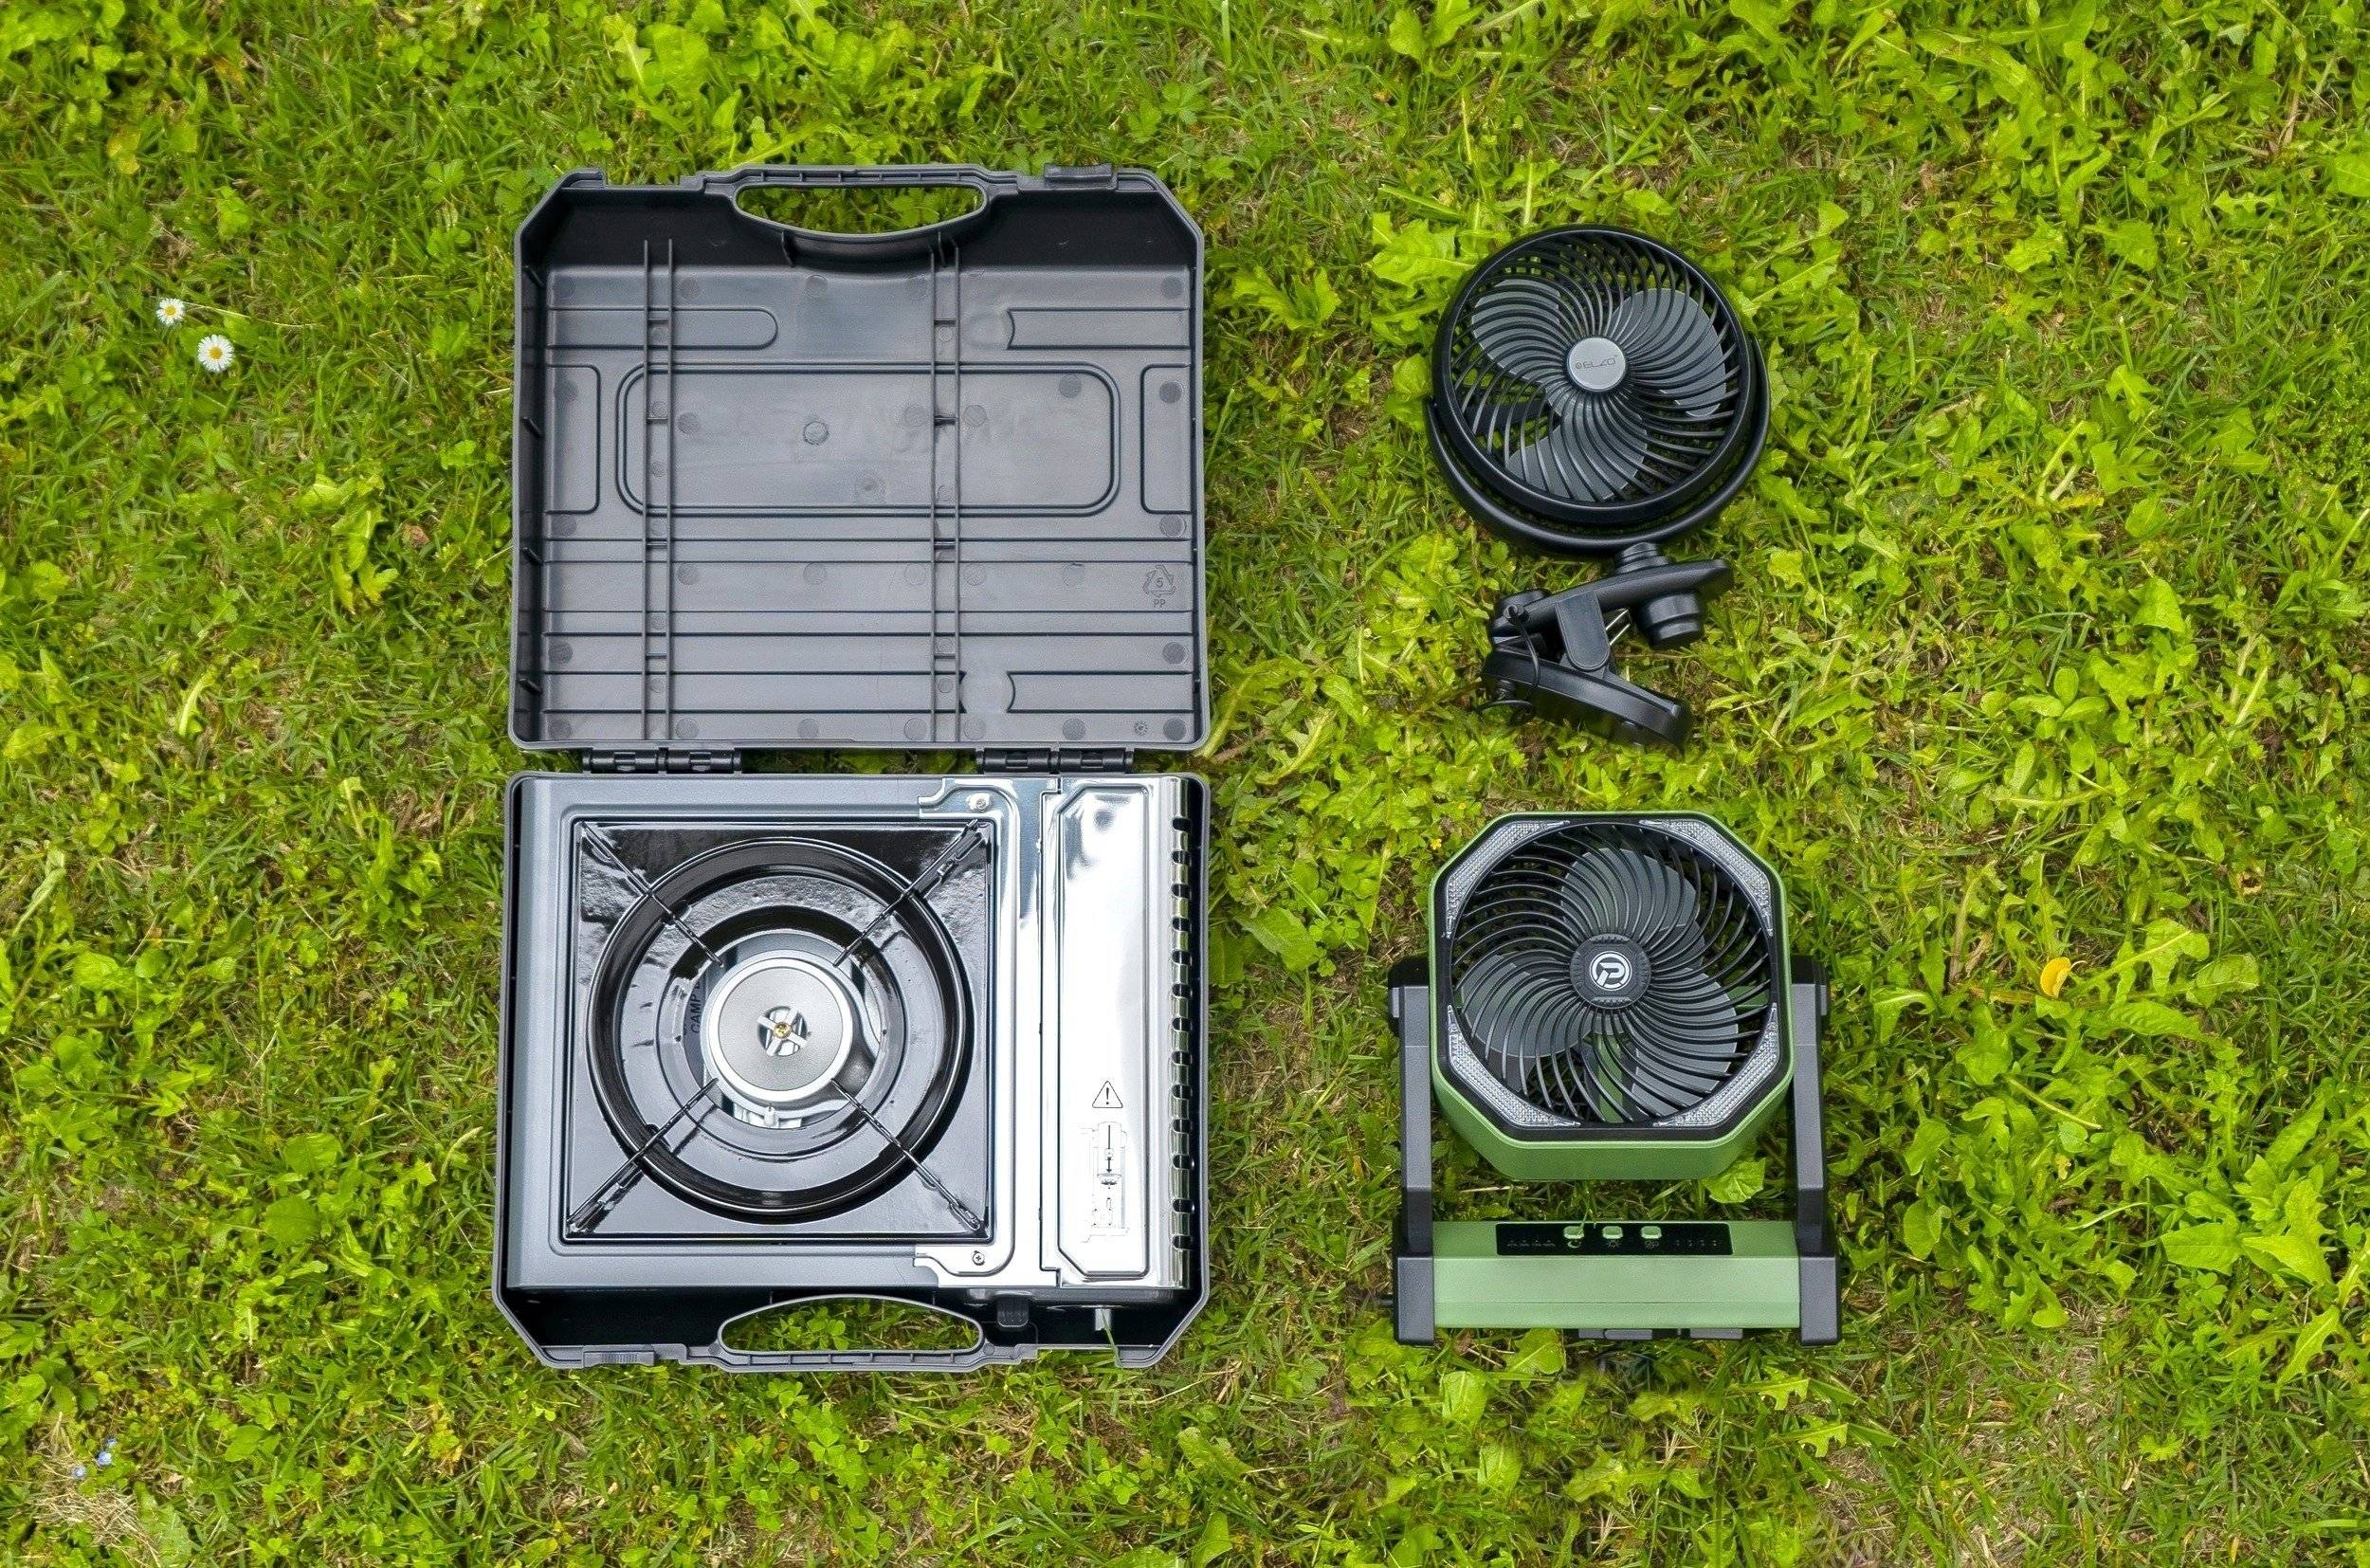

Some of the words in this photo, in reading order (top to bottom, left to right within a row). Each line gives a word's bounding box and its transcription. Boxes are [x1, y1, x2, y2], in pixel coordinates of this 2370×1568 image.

[1156, 577, 1164, 588] 5
[1153, 598, 1166, 608] PP
[690, 994, 702, 1033] CAMP
